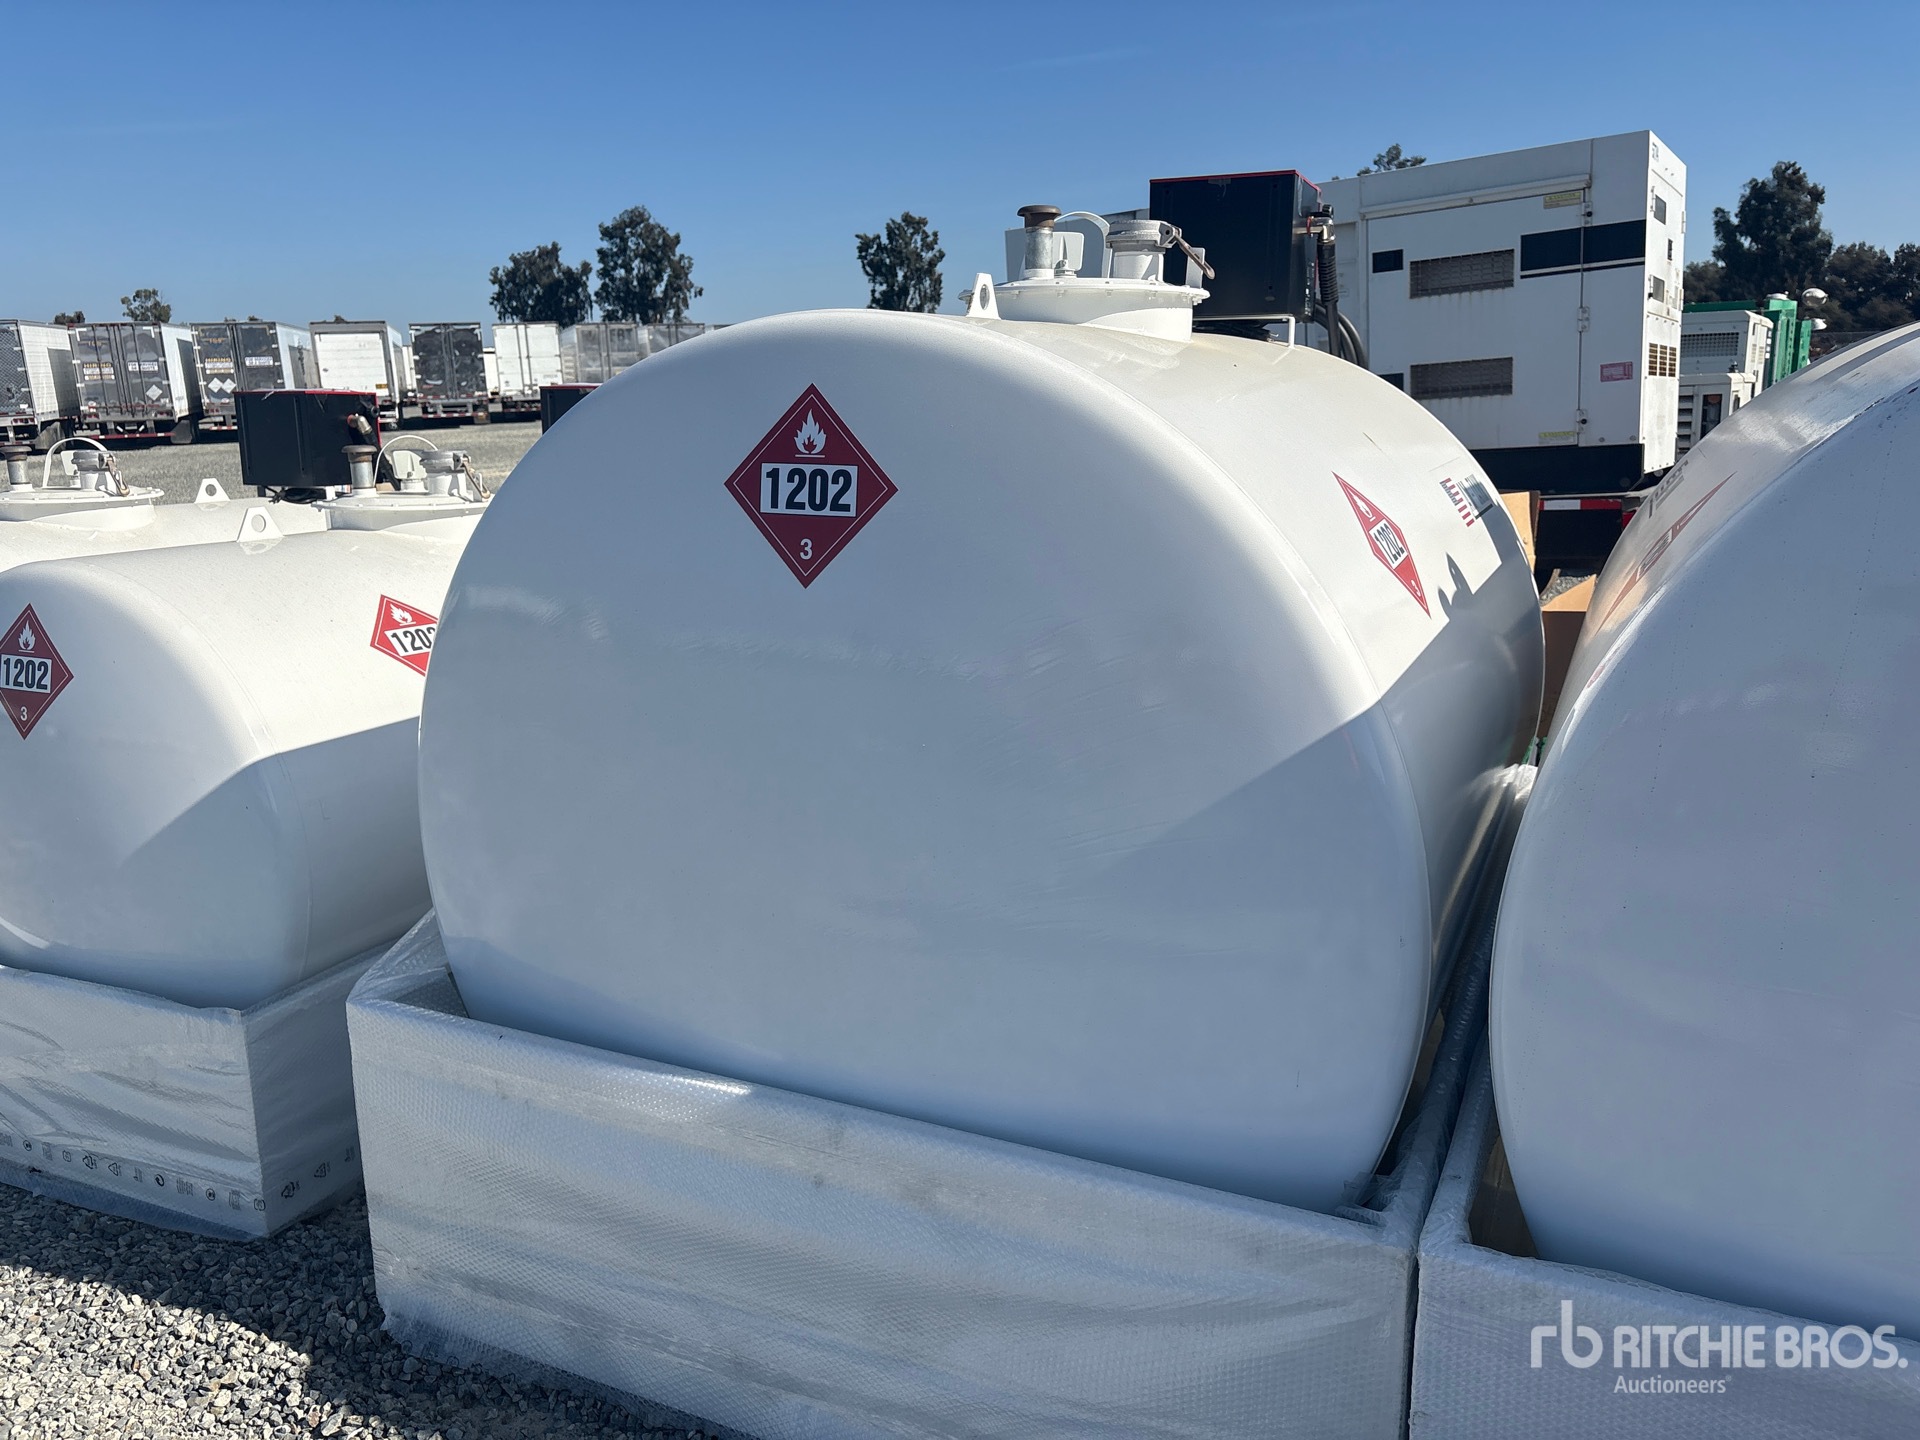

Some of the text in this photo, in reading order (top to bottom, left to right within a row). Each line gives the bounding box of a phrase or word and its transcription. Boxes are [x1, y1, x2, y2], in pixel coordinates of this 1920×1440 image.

[766, 467, 852, 512] 1202
[800, 538, 813, 560] 3
[1373, 523, 1405, 564] 1202
[3, 657, 49, 690] 1202
[20, 706, 28, 721] 3
